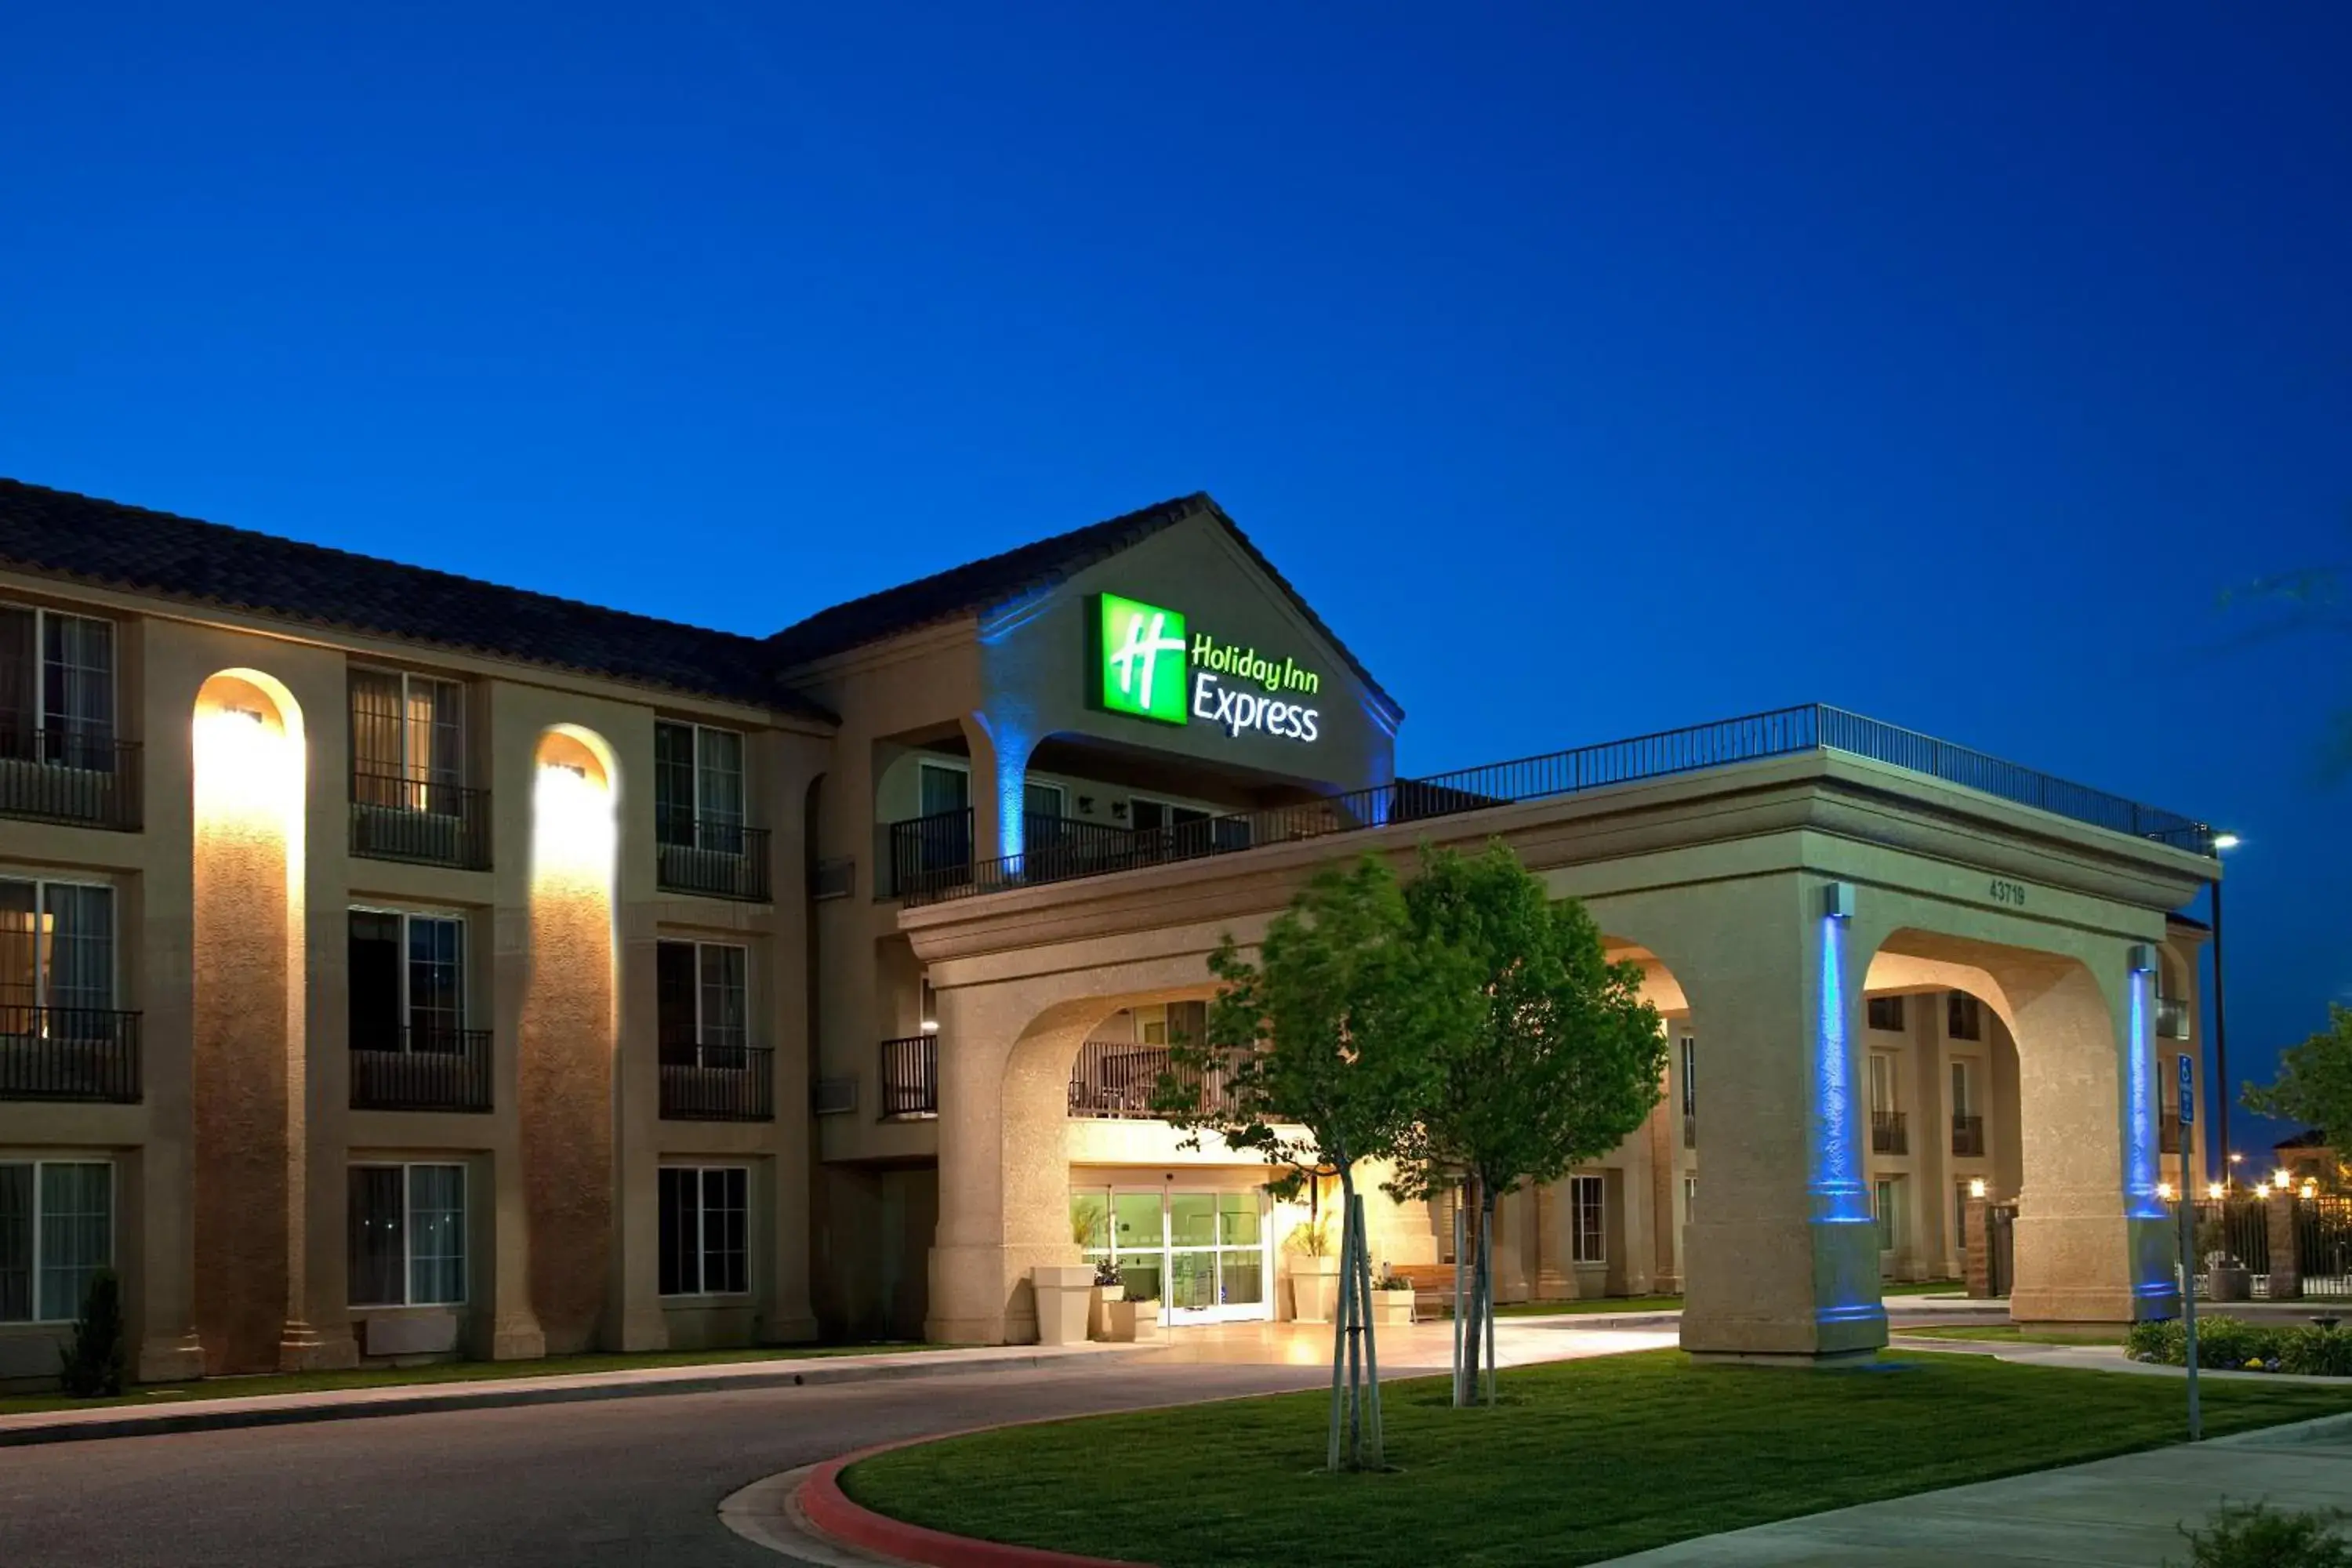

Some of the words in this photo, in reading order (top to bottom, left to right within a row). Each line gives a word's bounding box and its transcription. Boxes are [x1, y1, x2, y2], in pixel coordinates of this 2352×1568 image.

[1192, 633, 1281, 691] Holiday
[1284, 657, 1319, 694] Inn
[1194, 673, 1319, 742] Express
[1990, 879, 2024, 906] 43719
